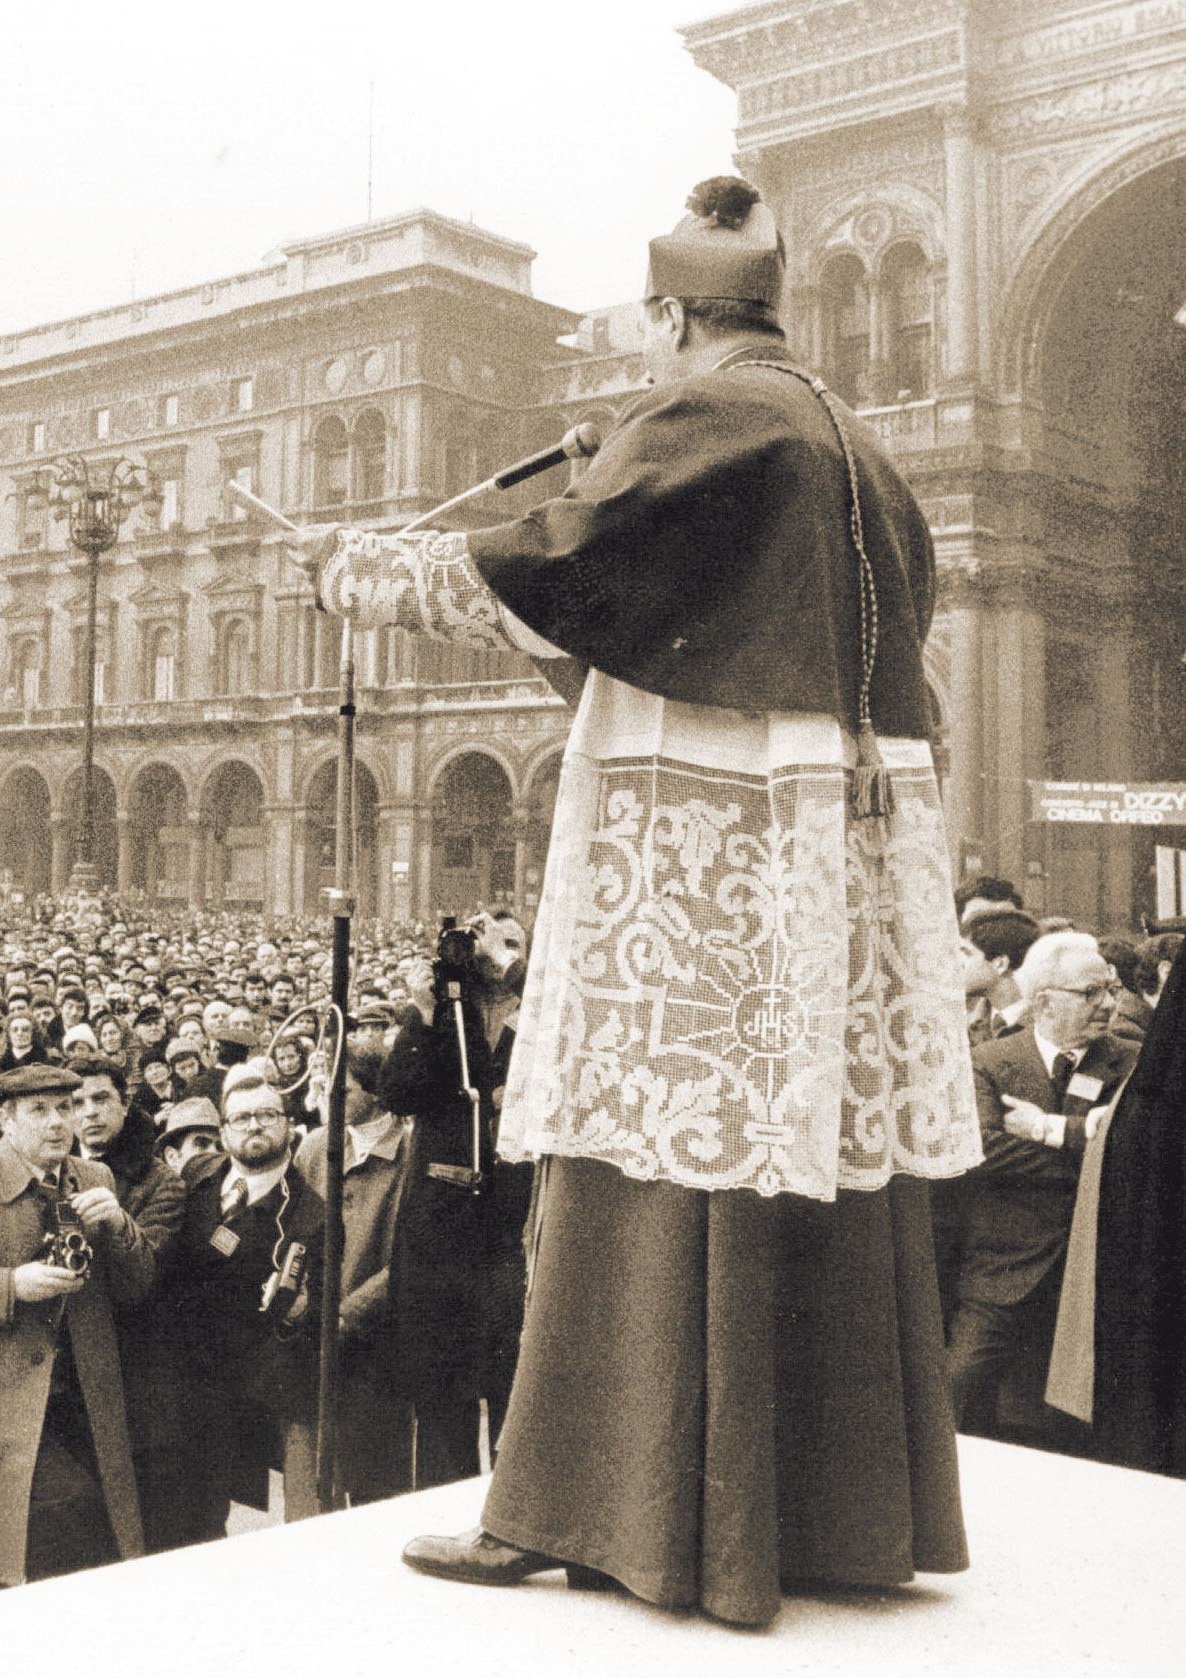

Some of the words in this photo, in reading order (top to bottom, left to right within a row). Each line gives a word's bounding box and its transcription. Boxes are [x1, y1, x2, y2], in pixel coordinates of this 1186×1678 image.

[1124, 792, 1186, 811] DIZZY
[1047, 807, 1103, 822] CINEMA
[1110, 810, 1164, 824] ORFEO
